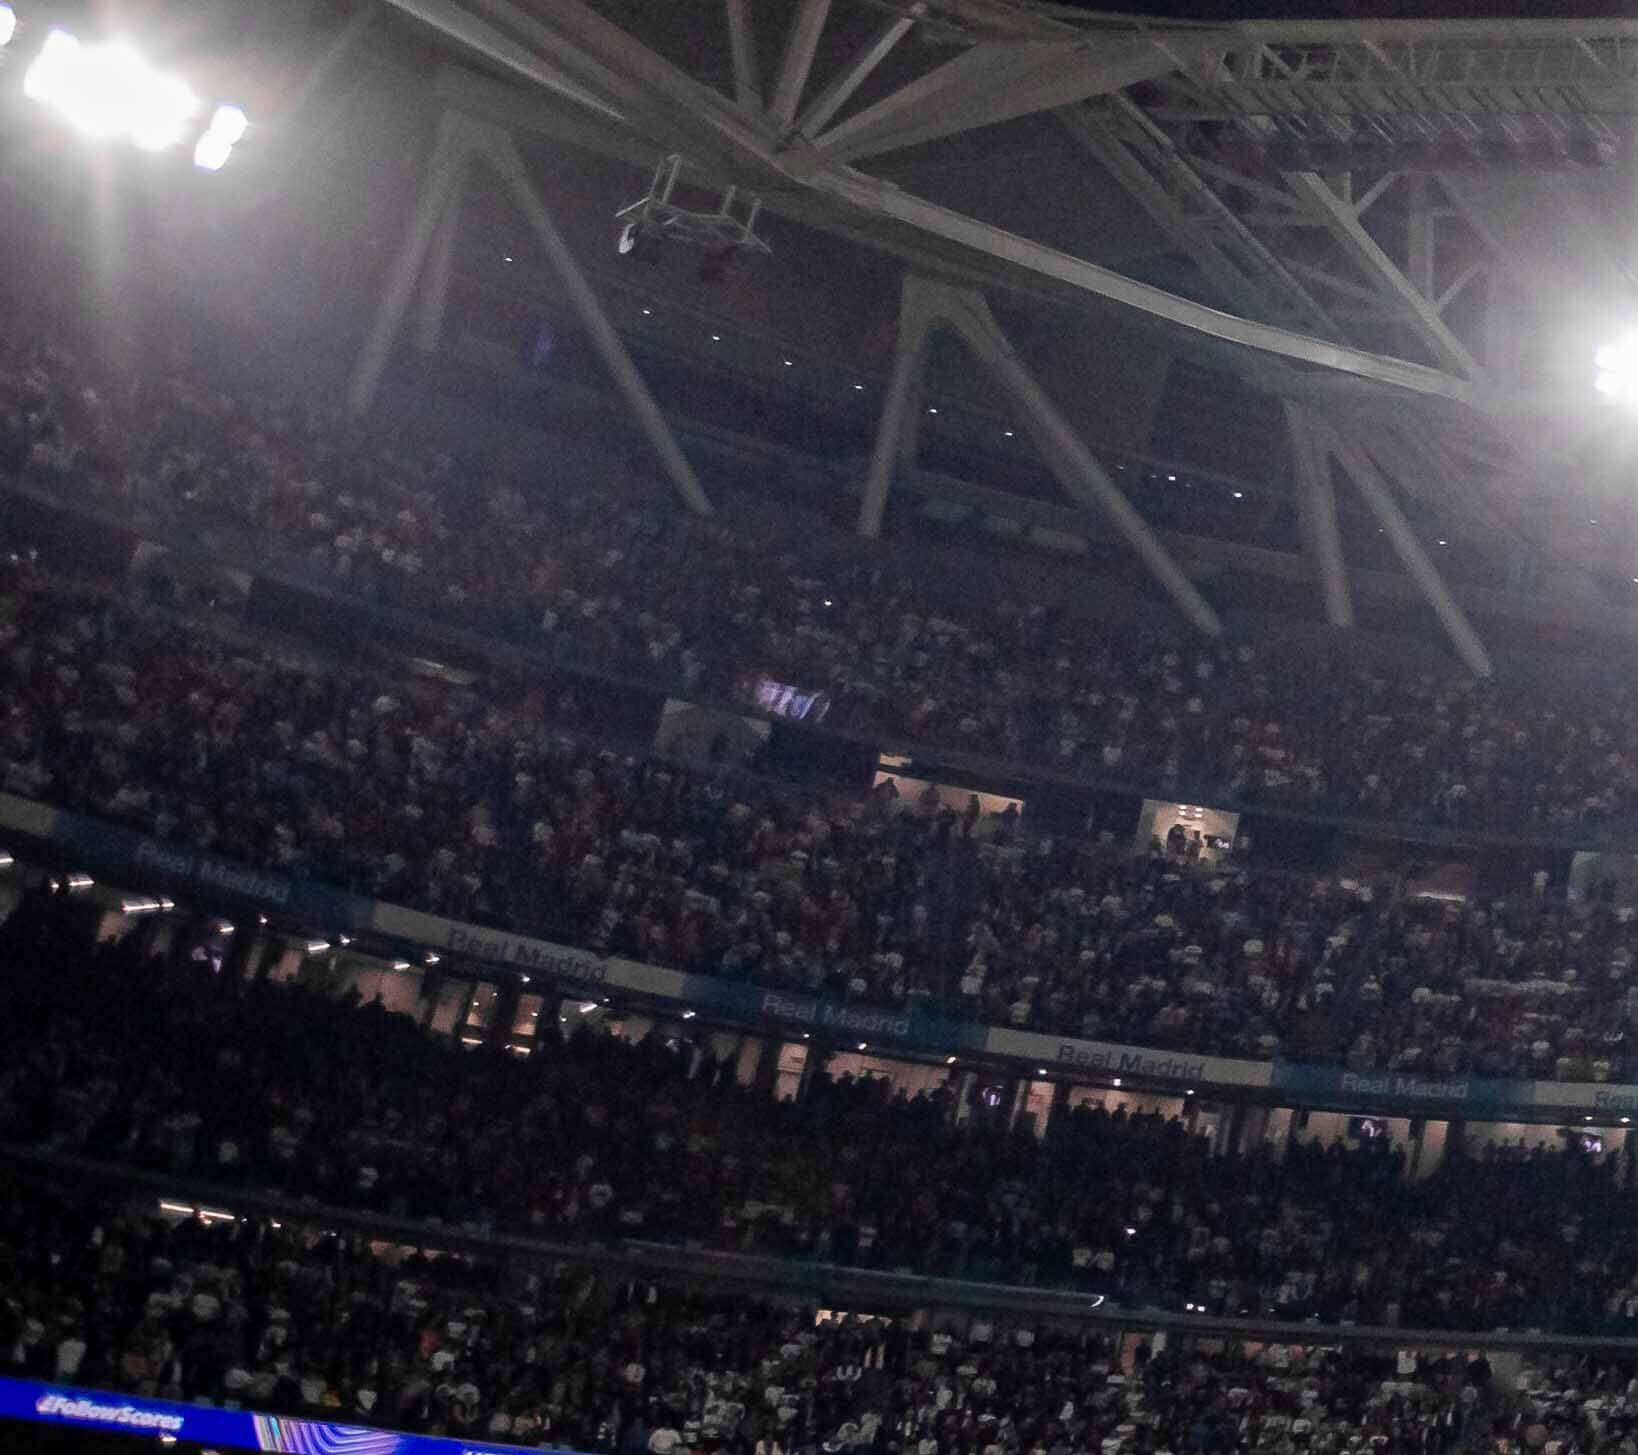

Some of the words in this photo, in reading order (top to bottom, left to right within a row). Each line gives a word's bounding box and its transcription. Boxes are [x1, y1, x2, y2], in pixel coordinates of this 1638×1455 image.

[448, 928, 508, 958] Real
[516, 944, 609, 981] Madrid
[763, 994, 818, 1022] Real
[822, 1006, 910, 1035] Madrid
[1058, 1045, 1113, 1070] Real
[1119, 1055, 1207, 1081] Madrid
[1341, 1073, 1391, 1094] Real
[1395, 1077, 1469, 1098] Madrid
